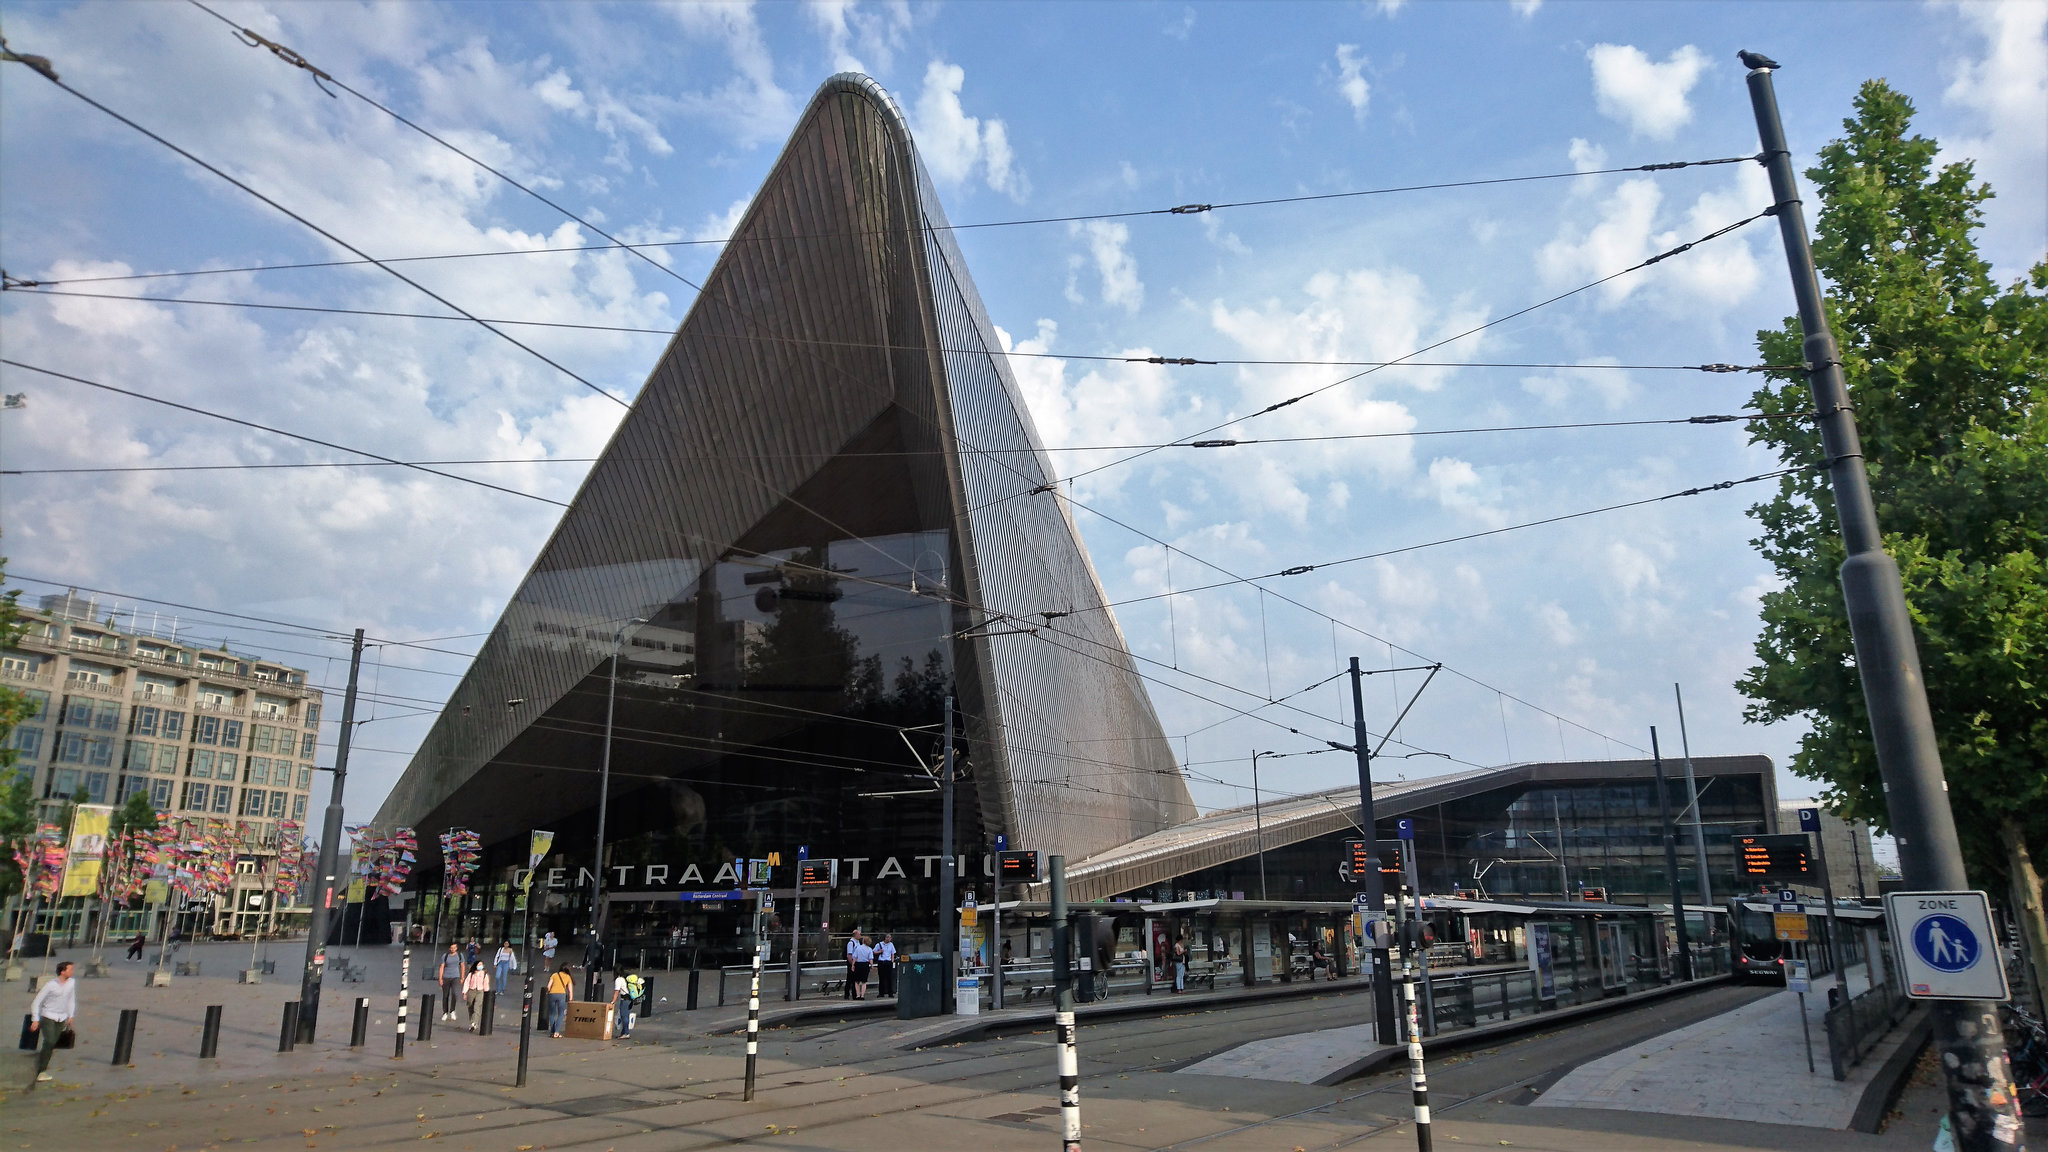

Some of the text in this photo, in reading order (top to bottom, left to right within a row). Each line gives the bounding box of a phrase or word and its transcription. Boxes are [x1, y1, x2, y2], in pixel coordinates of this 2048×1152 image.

[1801, 810, 1812, 821] D
[1399, 820, 1407, 830] C
[997, 835, 1003, 844] B
[799, 846, 805, 854] A
[767, 852, 780, 866] M
[513, 862, 768, 889] CENTRAAL
[967, 892, 973, 900] B
[1359, 894, 1367, 903] C
[1783, 891, 1793, 901] D
[1918, 900, 1958, 910] ZONE
[573, 1016, 597, 1024] TREK
